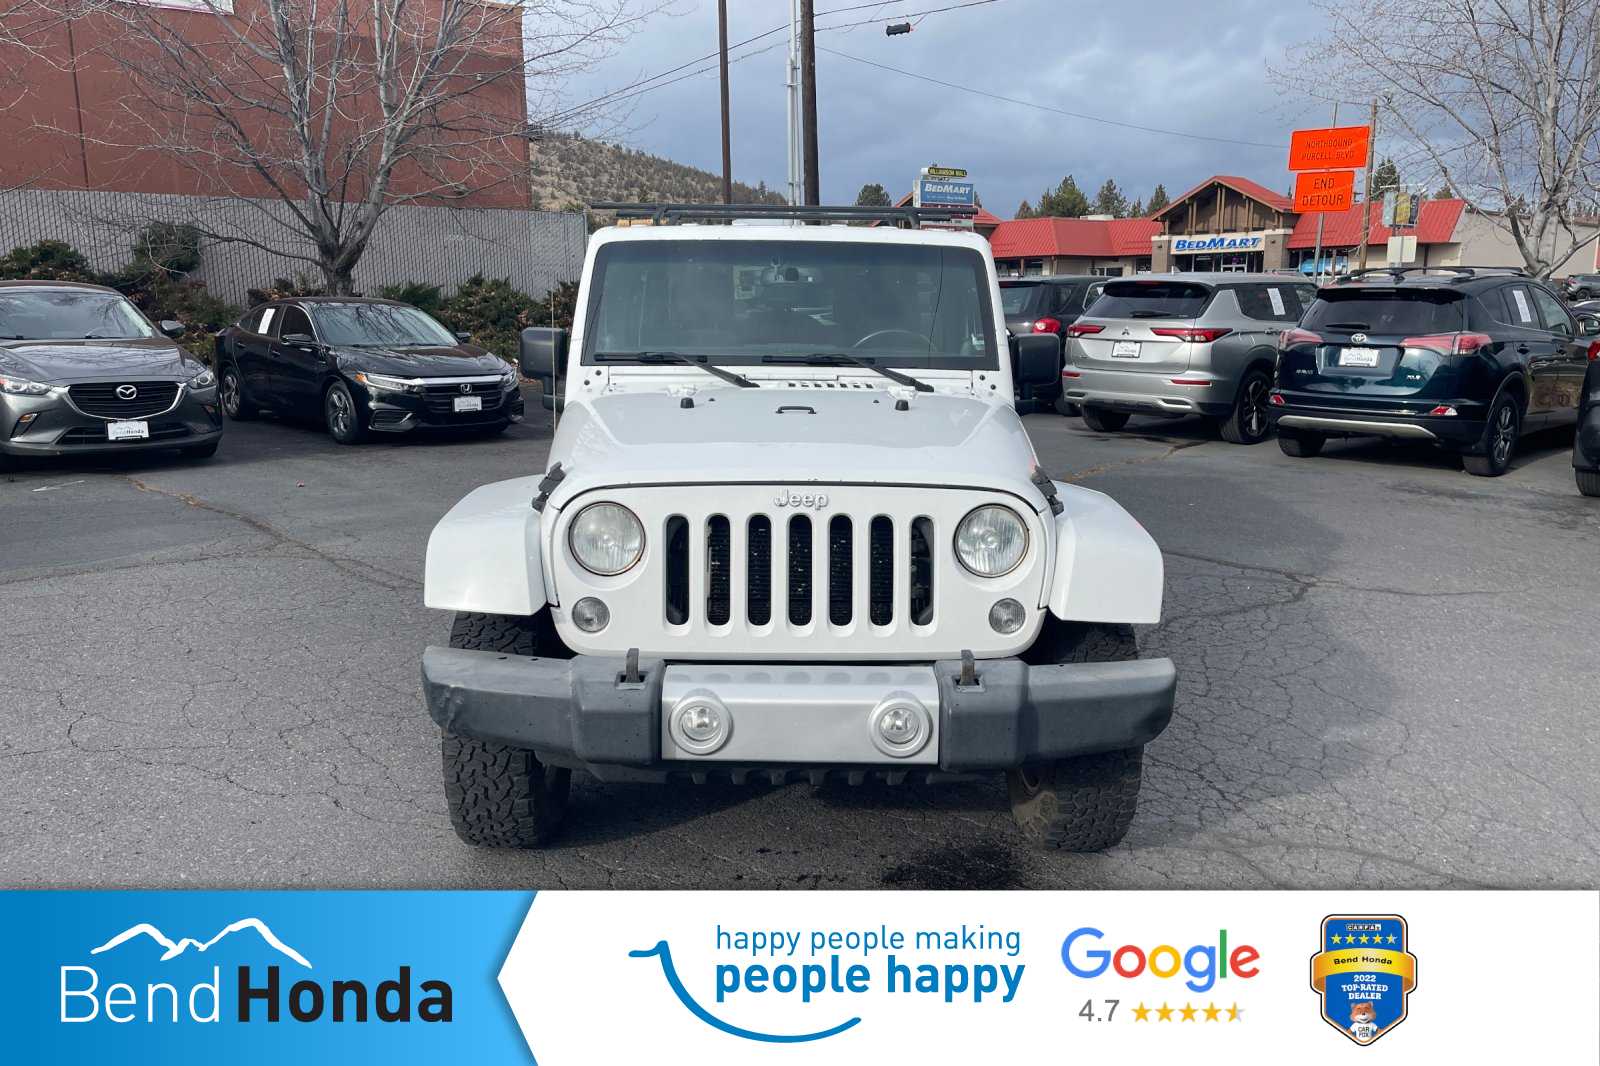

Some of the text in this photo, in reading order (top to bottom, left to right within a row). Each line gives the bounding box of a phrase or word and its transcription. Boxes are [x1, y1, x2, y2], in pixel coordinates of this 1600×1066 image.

[1306, 138, 1353, 148] NORTHBOUND
[1303, 152, 1332, 161] PURCELL
[1313, 178, 1335, 189] END
[1302, 194, 1344, 206] DETOUR
[774, 488, 829, 511] Jeep
